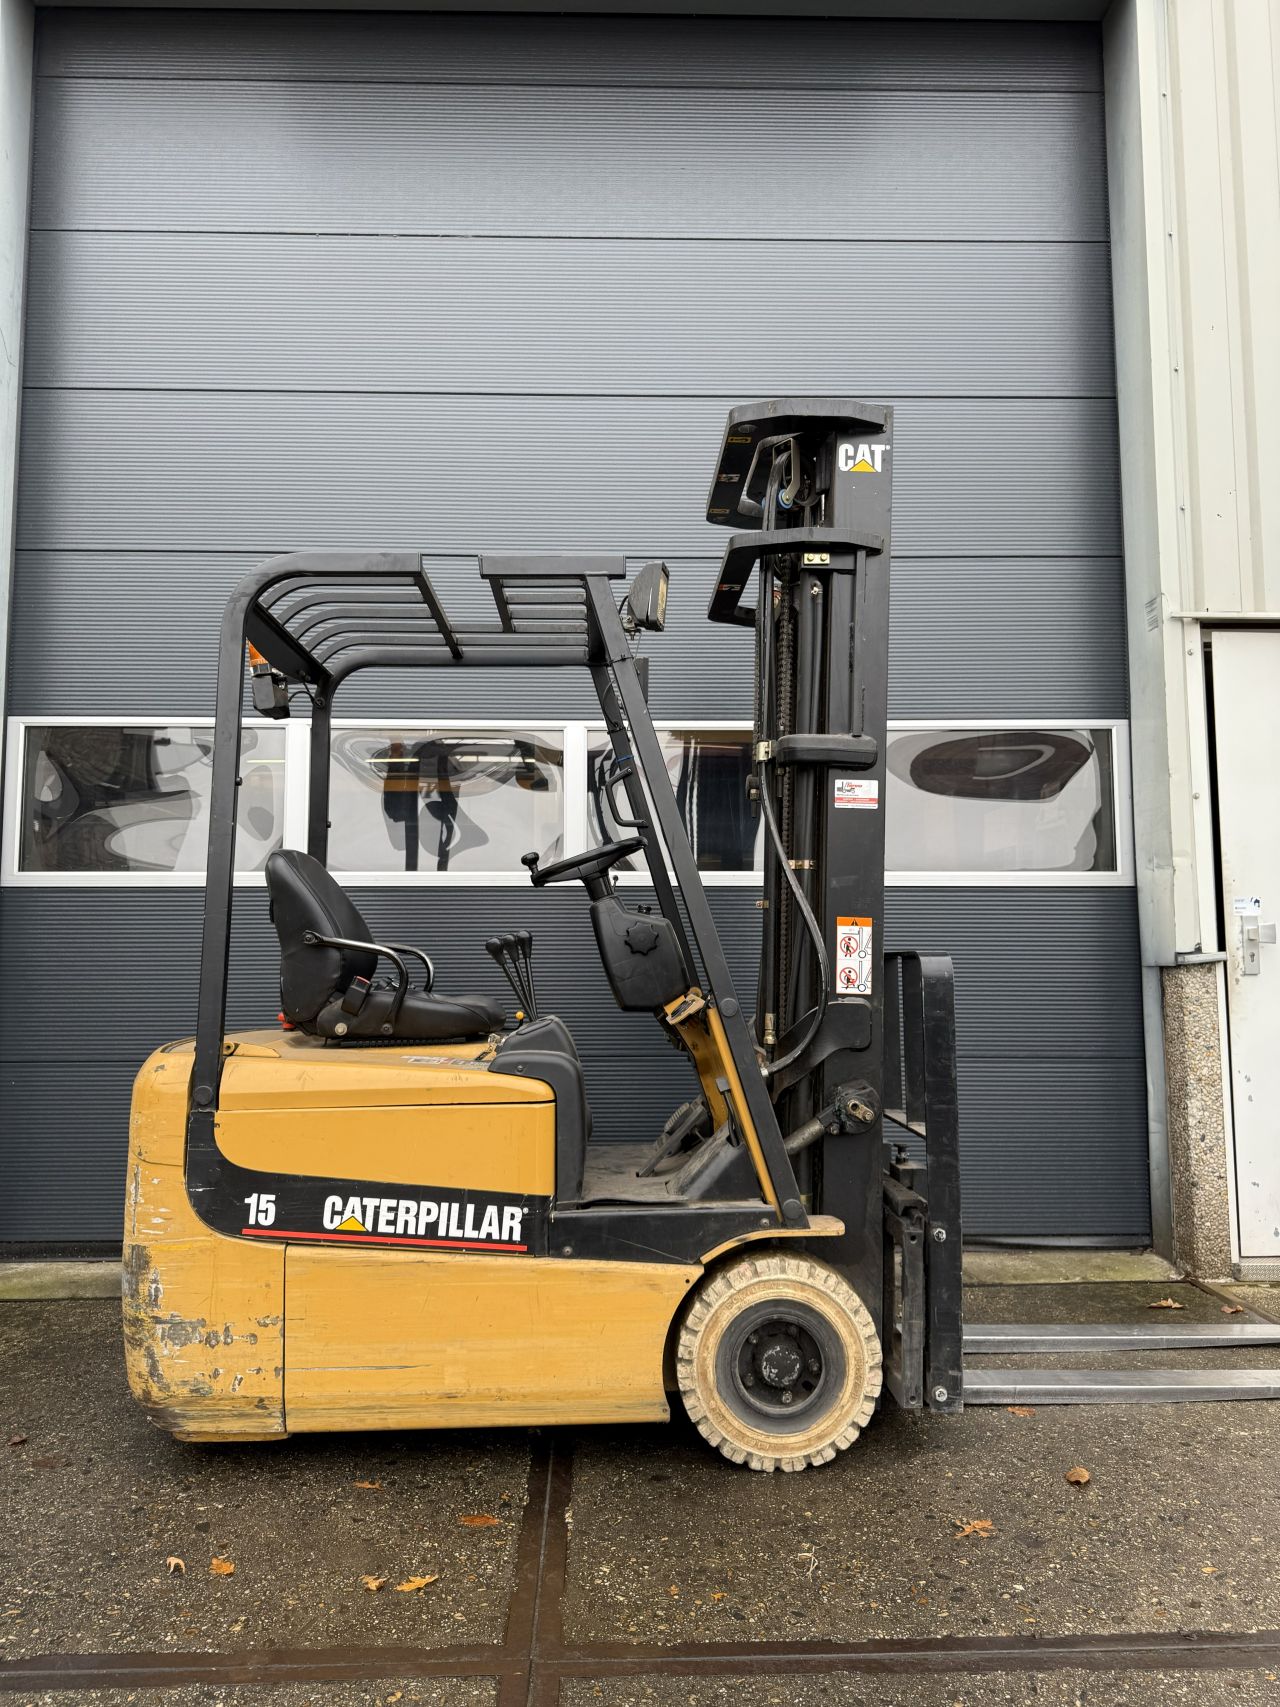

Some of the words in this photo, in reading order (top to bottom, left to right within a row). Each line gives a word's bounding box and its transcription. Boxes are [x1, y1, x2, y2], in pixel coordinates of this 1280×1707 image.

[838, 443, 885, 473] CAT
[244, 1192, 276, 1227] 15
[322, 1195, 523, 1242] CATERPILLAR
